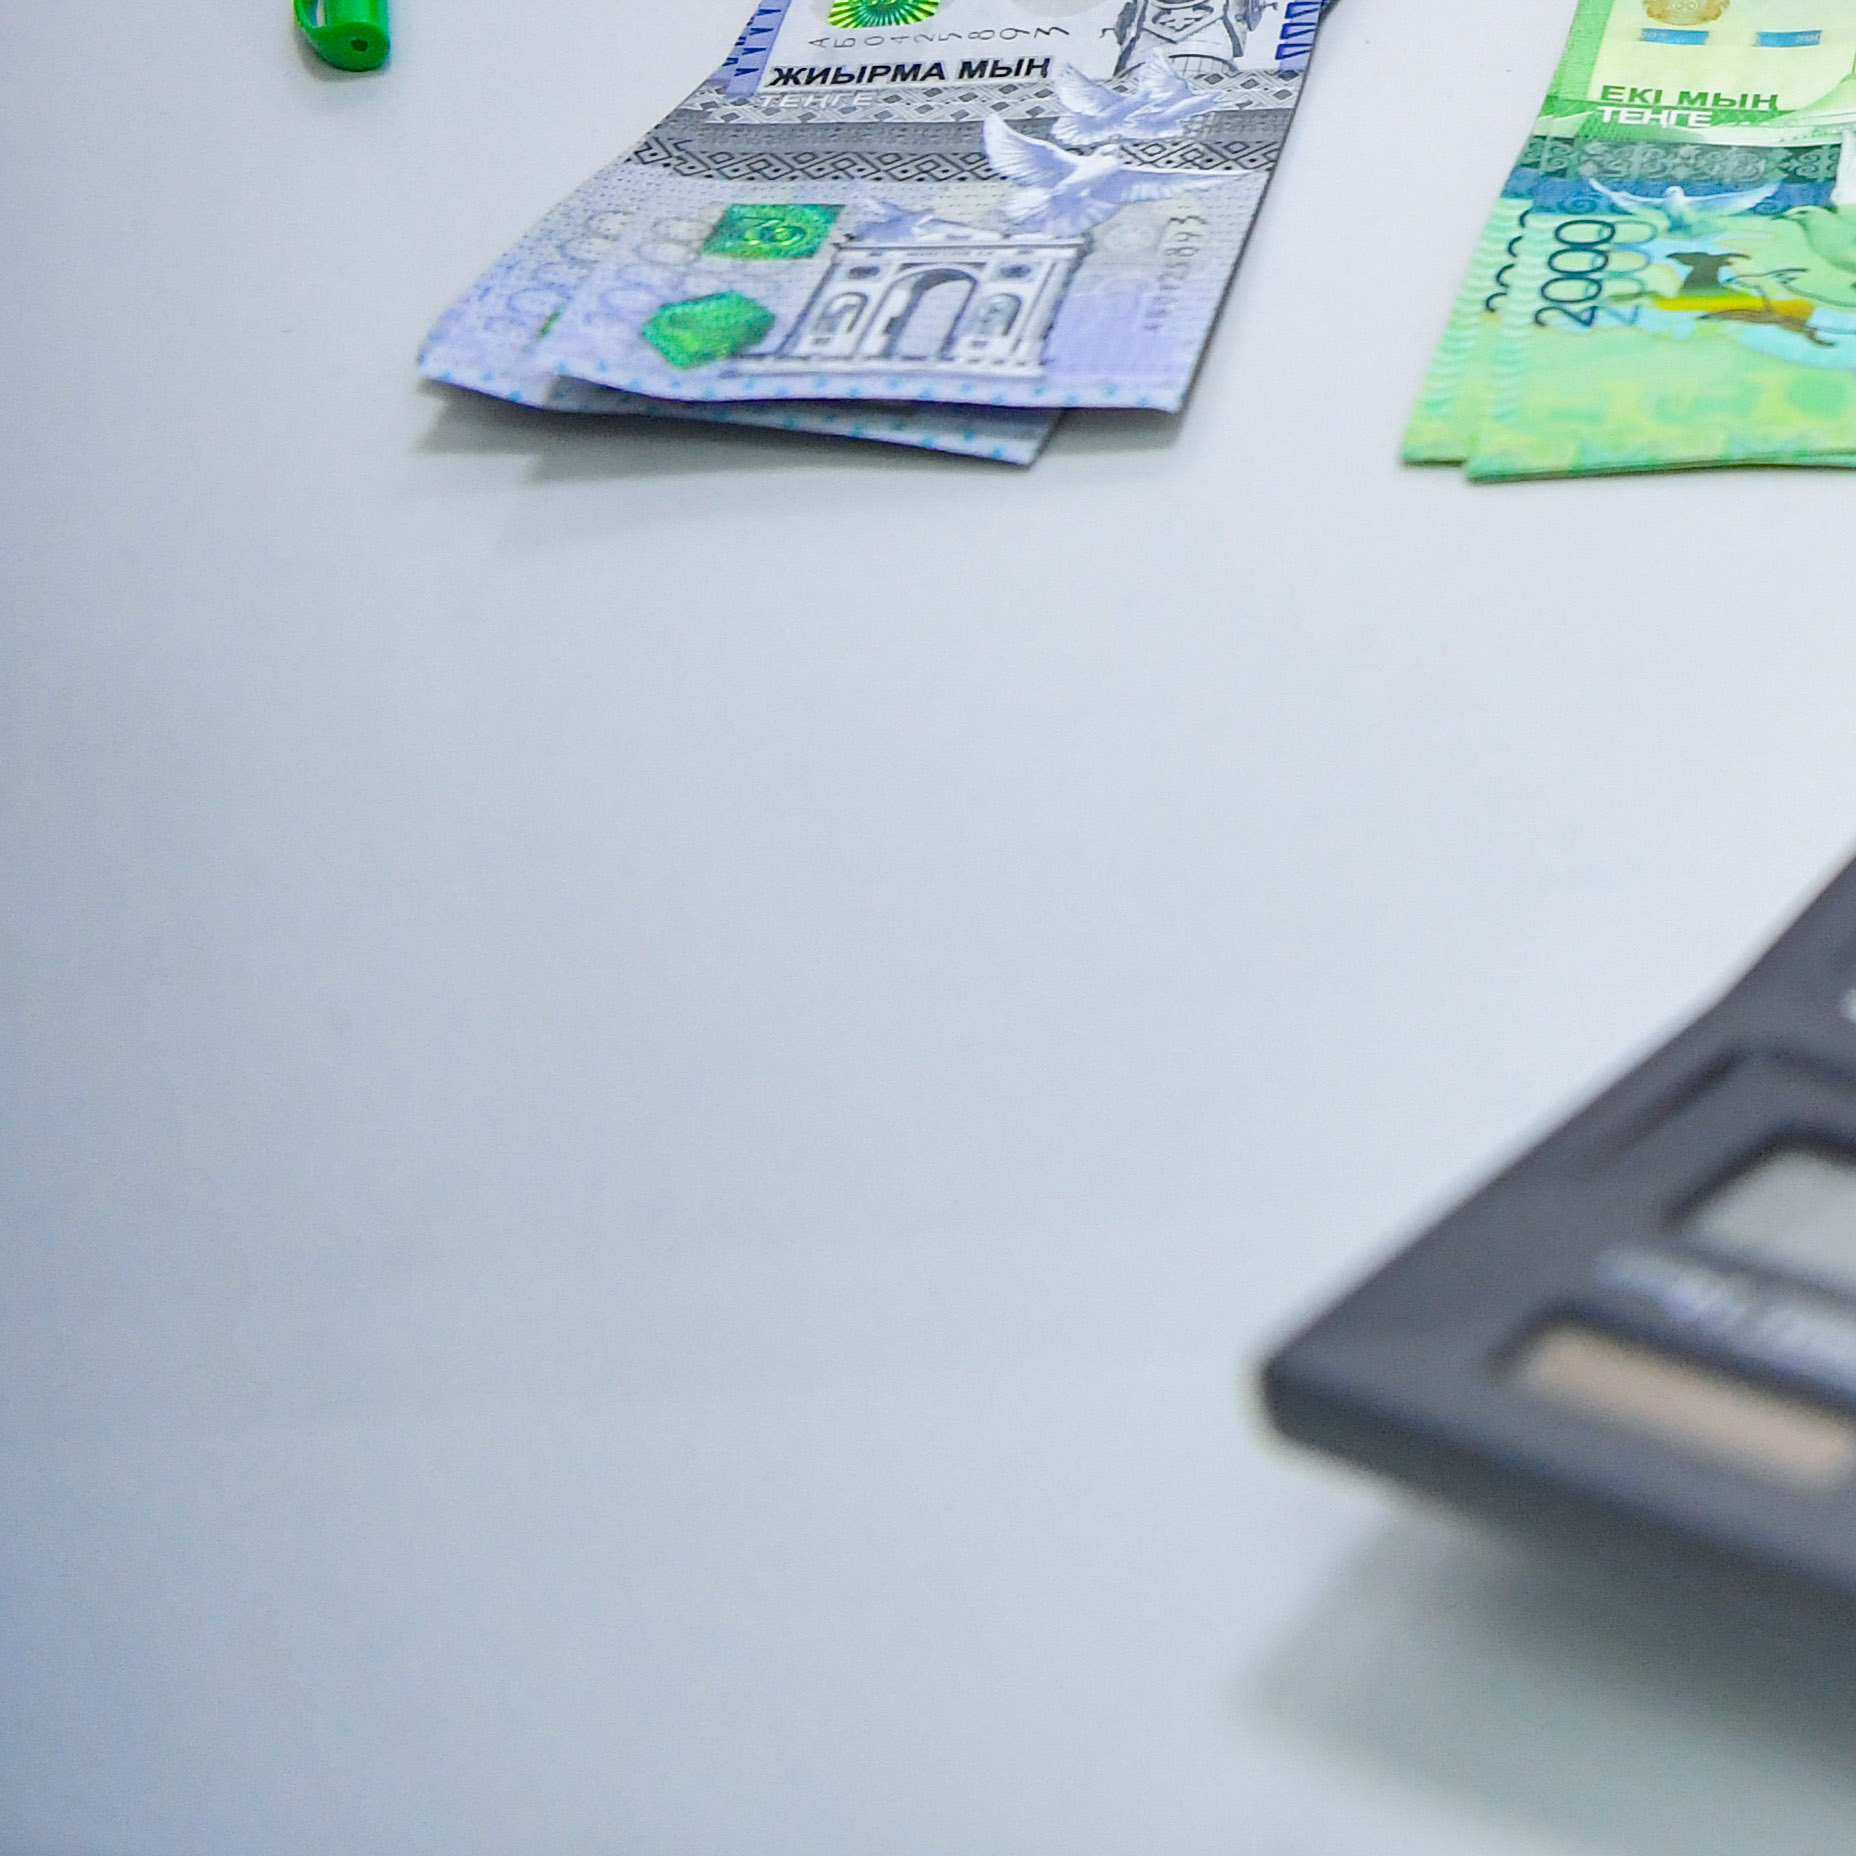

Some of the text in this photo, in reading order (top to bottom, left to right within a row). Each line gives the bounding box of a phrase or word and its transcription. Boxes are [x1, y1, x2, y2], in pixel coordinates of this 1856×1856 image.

[766, 56, 1052, 88] ЖИЫРМА МЫҢ
[1600, 84, 1779, 112] ЕКІ МЫҢ
[1597, 105, 1713, 128] ТЕҢГЕ
[1533, 218, 1617, 328] 2000
